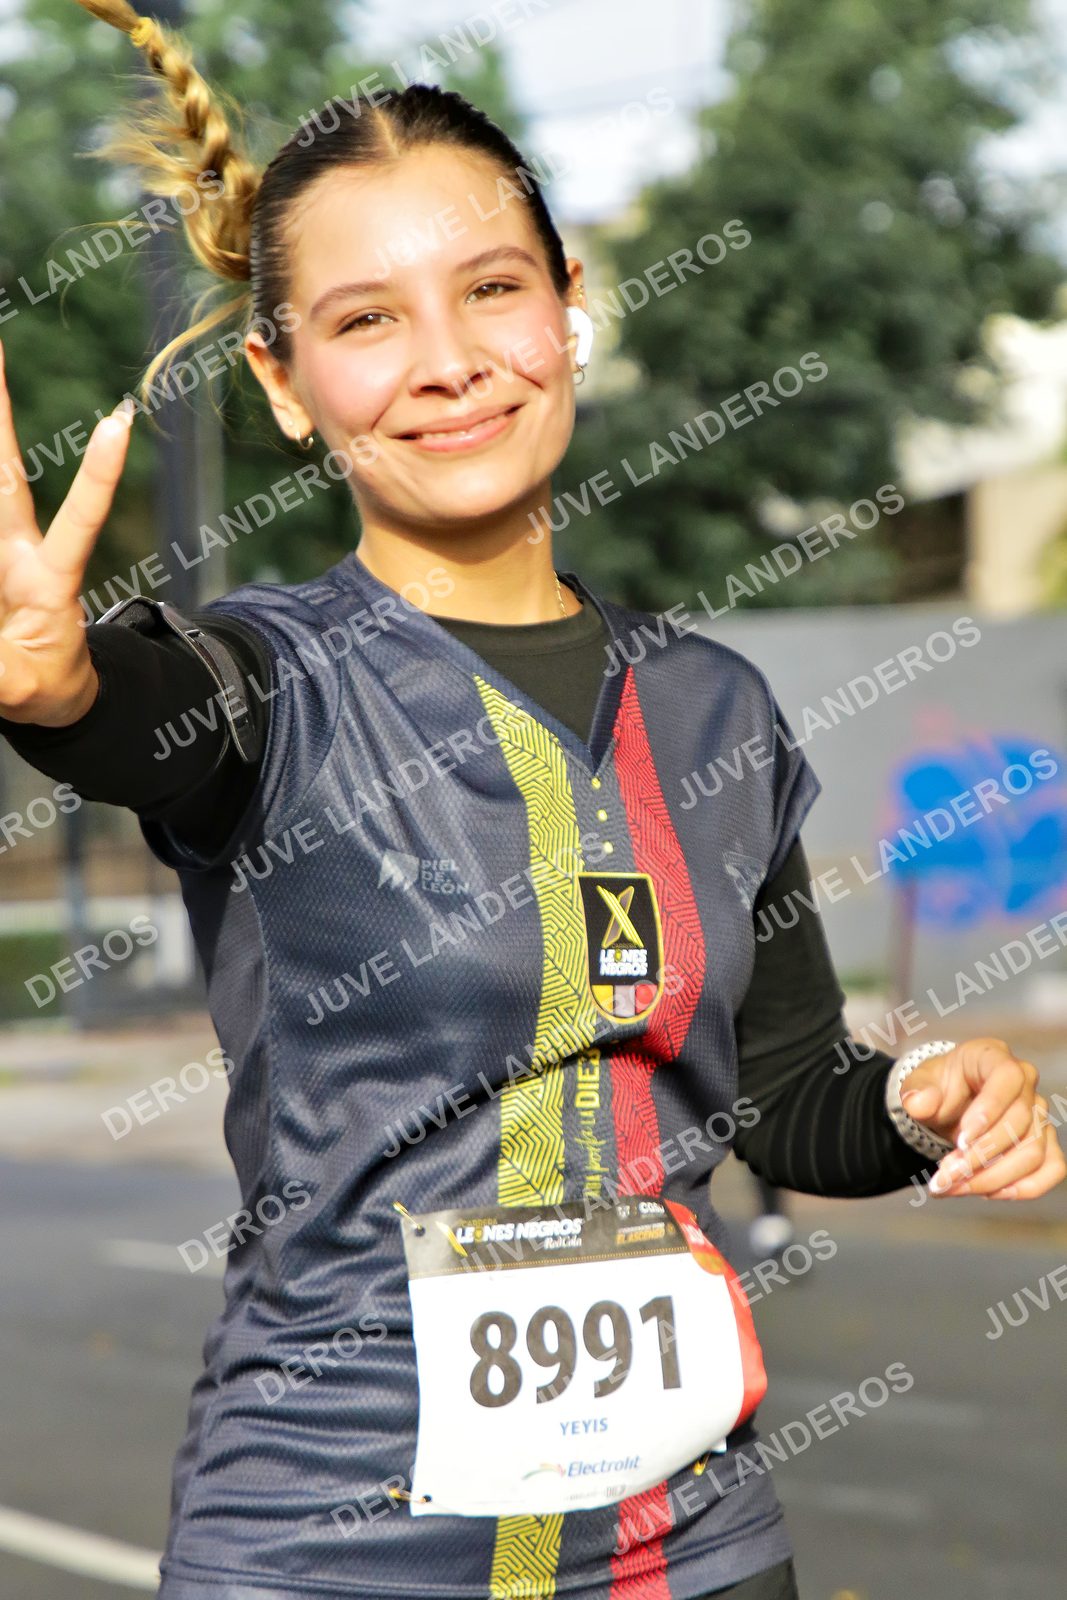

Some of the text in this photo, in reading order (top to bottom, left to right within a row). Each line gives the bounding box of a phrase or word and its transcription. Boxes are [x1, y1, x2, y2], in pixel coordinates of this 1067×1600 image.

[421, 859, 459, 871] PIEL
[600, 962, 649, 976] NEGROS
[516, 1218, 582, 1239] NEGROS
[470, 1295, 682, 1408] 8991
[559, 1417, 609, 1436] YEYIS
